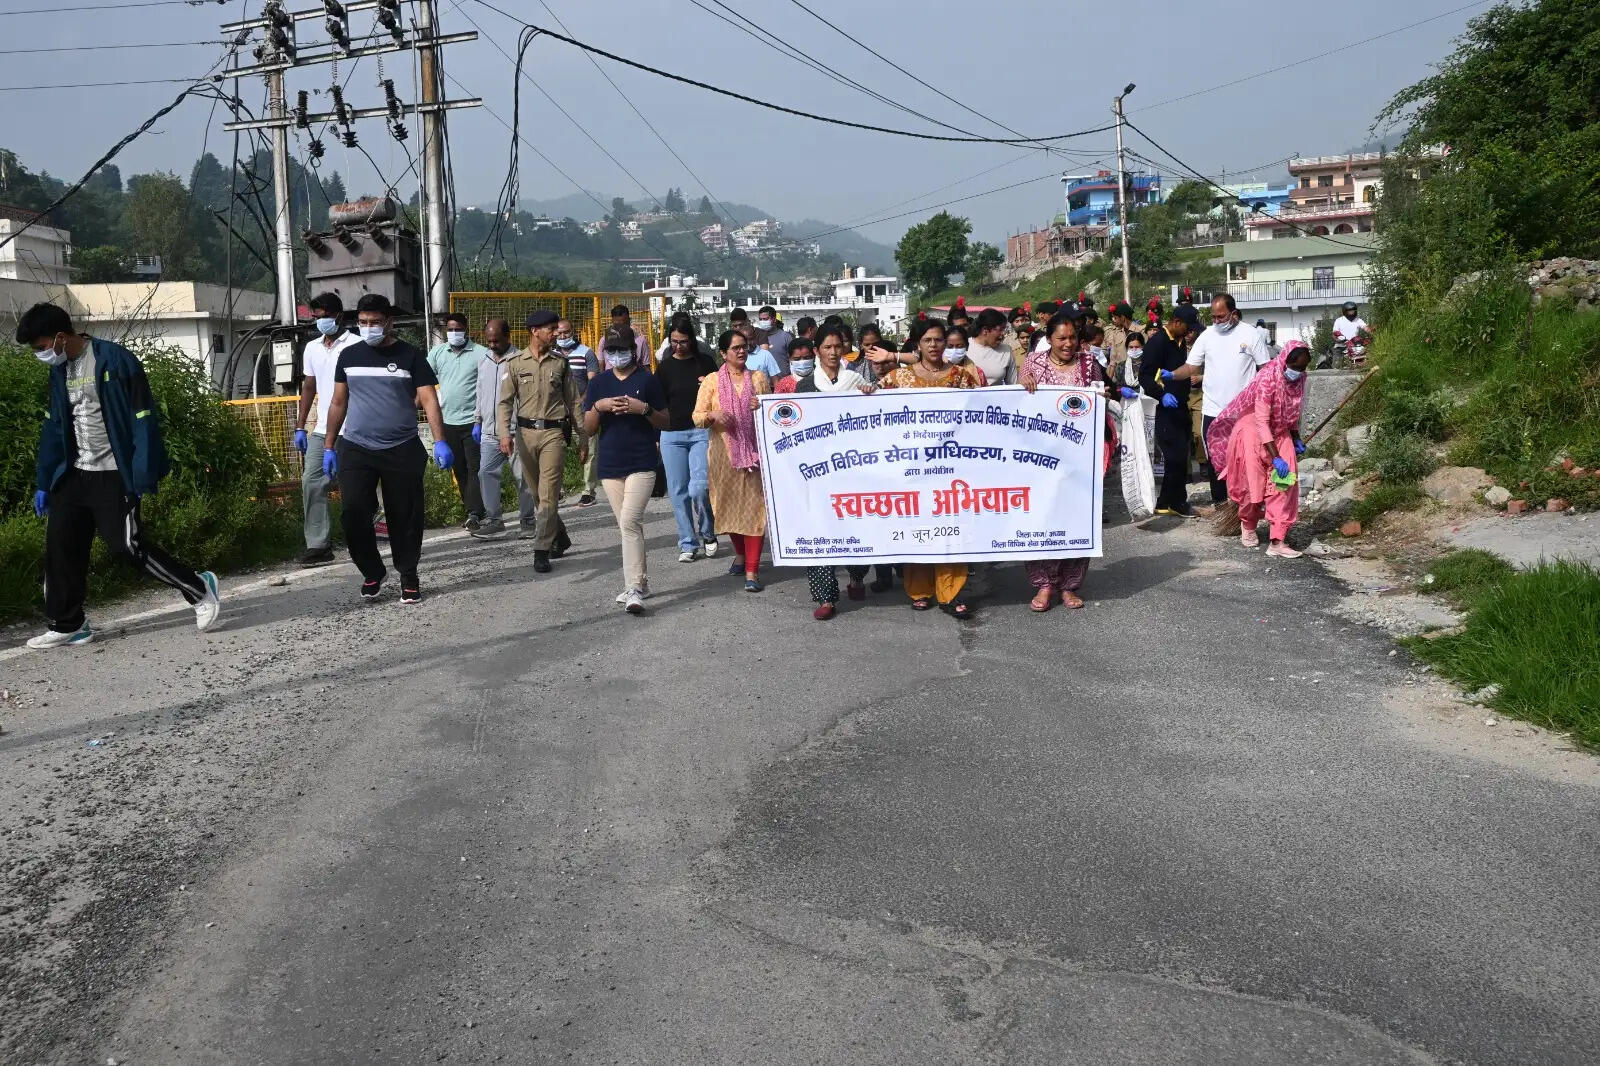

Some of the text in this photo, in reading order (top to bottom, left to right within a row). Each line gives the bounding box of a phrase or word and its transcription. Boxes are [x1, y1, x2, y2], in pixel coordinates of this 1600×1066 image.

[792, 430, 805, 446] उच्च
[804, 421, 837, 440] न्यायालय,
[837, 413, 868, 432] नैनीताल
[869, 408, 882, 429] एवं
[883, 405, 916, 426] माननीय
[919, 409, 963, 425] उत्तराखण्ड
[964, 410, 984, 425] राज्य
[986, 405, 1011, 426] विधिक
[1011, 409, 1027, 429] सेवा
[1027, 413, 1059, 438] प्राधिकरण,
[903, 429, 955, 441] के निर्देशानुसार
[799, 440, 1060, 482] जिला विधिक सेवा प्राधिकरण, चम्पावत
[904, 465, 954, 477] द्वारा आयोजित
[830, 478, 1031, 520] स्वच्छता अभियान
[892, 530, 905, 541] 21
[1016, 529, 1031, 538] जिला
[991, 540, 1006, 548] जिला
